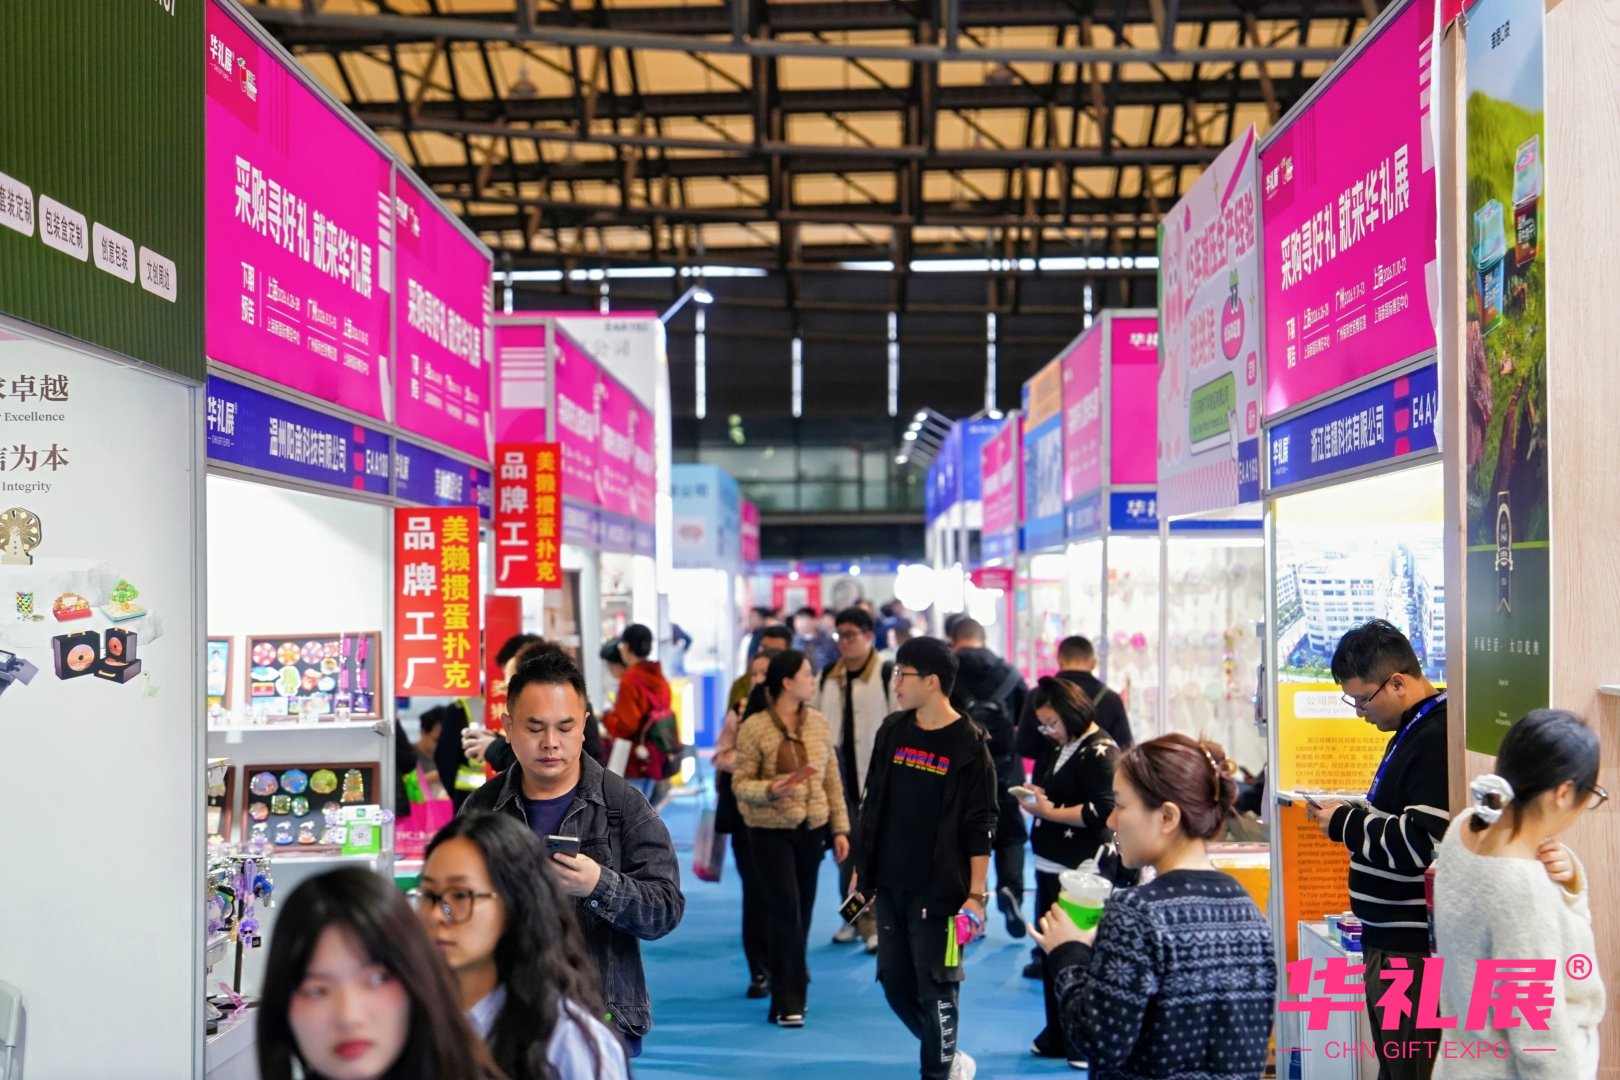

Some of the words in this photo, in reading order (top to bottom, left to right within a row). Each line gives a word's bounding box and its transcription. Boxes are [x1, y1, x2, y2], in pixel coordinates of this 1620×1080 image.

[45, 207, 84, 250] 包装盒定制
[234, 154, 310, 263] 采购寻好礼
[312, 209, 373, 300] 就来华礼展
[1281, 203, 1337, 292] 采购寻好礼
[1339, 143, 1410, 253] 就来华礼展
[101, 238, 128, 272] 创意包装
[147, 260, 171, 292] 文创周边
[0, 373, 70, 403] 卓越
[4, 412, 65, 422] Excellence
[207, 396, 235, 436] 华礼展
[1272, 436, 1289, 467] 华礼展
[2, 480, 52, 494] Integrity
[499, 452, 529, 582] 品牌工厂
[402, 516, 438, 690] 品牌工厂
[440, 515, 472, 690] 美獭掼蛋扑克
[893, 746, 950, 776] WORLD
